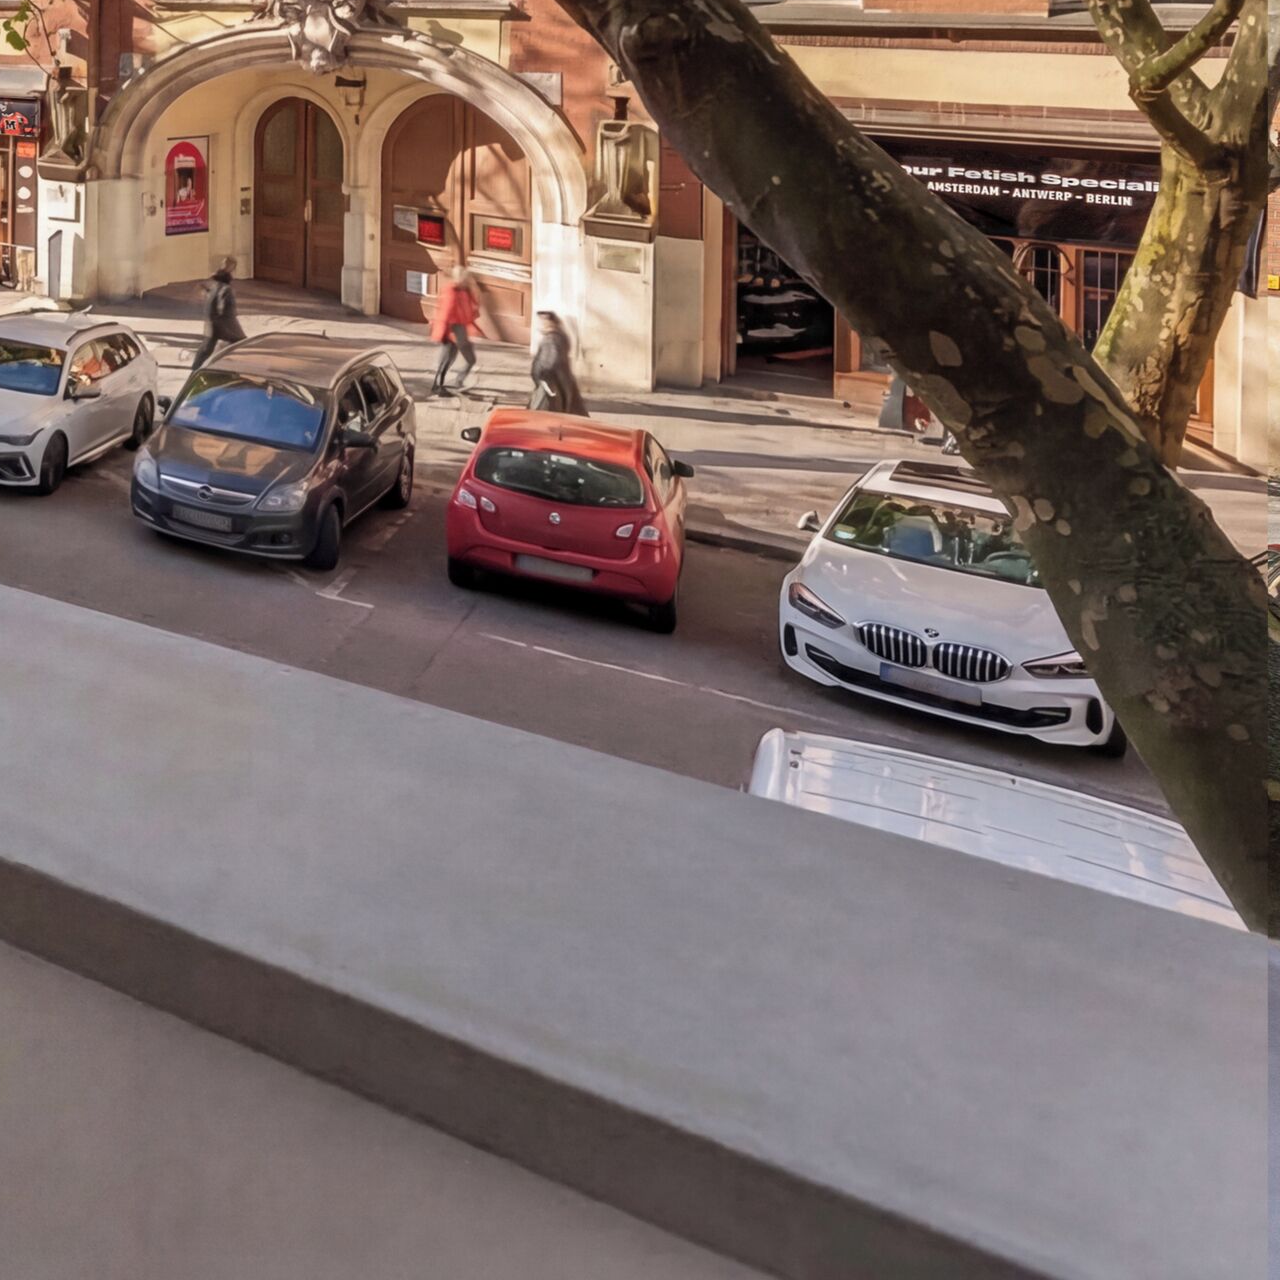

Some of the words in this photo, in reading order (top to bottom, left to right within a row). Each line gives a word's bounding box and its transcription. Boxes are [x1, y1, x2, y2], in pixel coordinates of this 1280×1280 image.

[947, 166, 1036, 184] Fetish
[1040, 172, 1160, 193] Speciali
[927, 181, 999, 197] AMSTERDAM
[1012, 187, 1072, 202] ANTWERP
[1085, 192, 1133, 207] BERLIN
